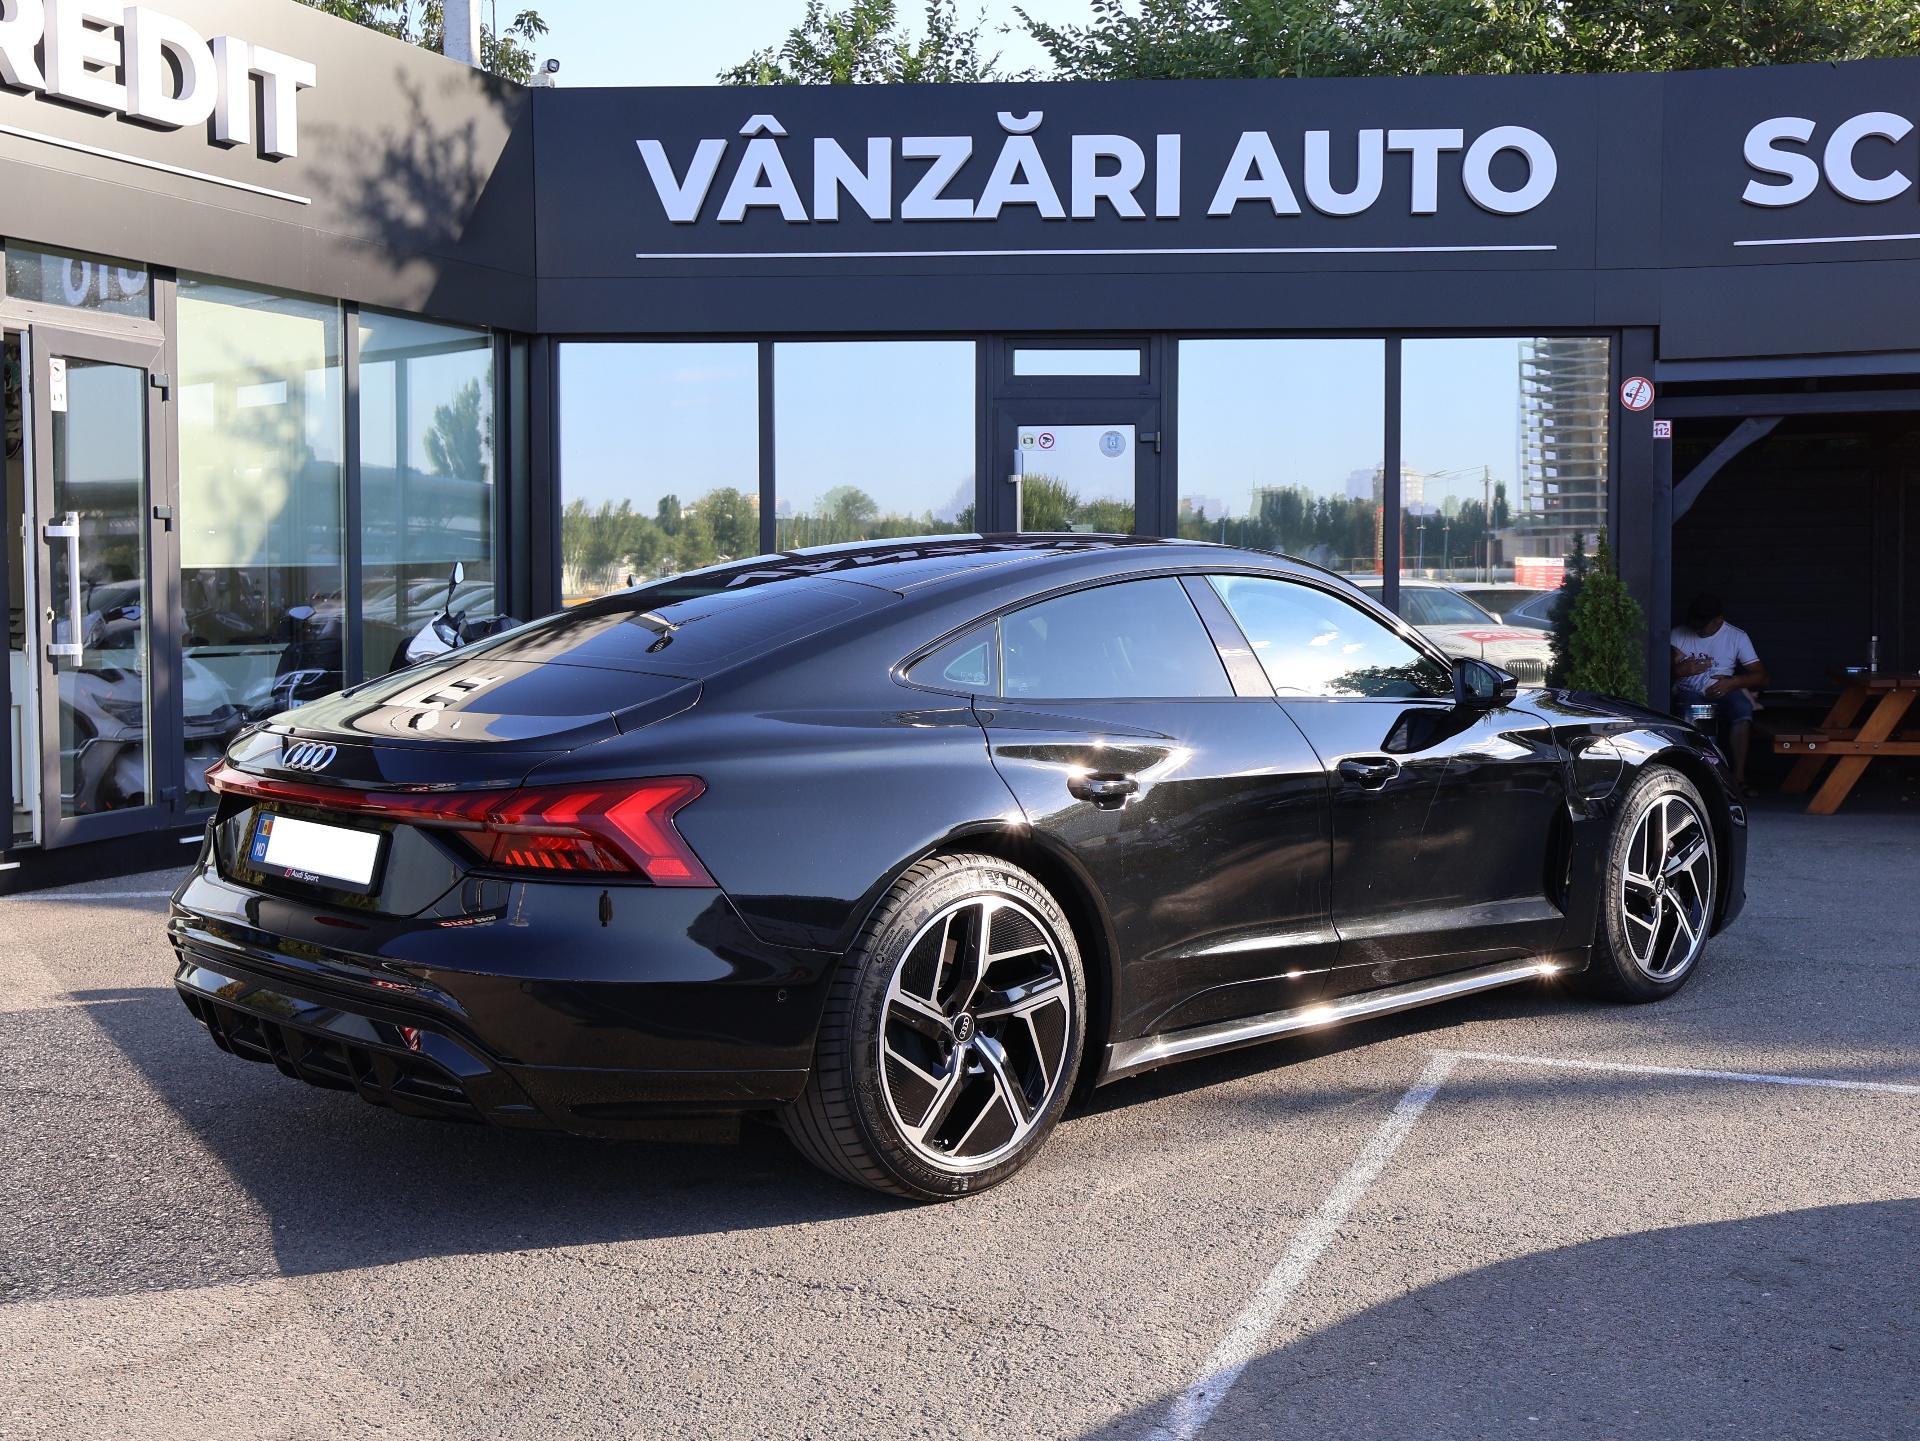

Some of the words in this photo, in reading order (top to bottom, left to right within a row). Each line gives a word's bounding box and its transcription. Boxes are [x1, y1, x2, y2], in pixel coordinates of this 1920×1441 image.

[636, 111, 1181, 223] VÂNZĂRI
[1206, 126, 1558, 217] AUTO
[1654, 428, 1670, 436] 112
[255, 842, 266, 857] MD
[291, 869, 304, 879] Audi
[303, 872, 319, 882] Sport
[1006, 875, 1058, 920] MICHELIN
